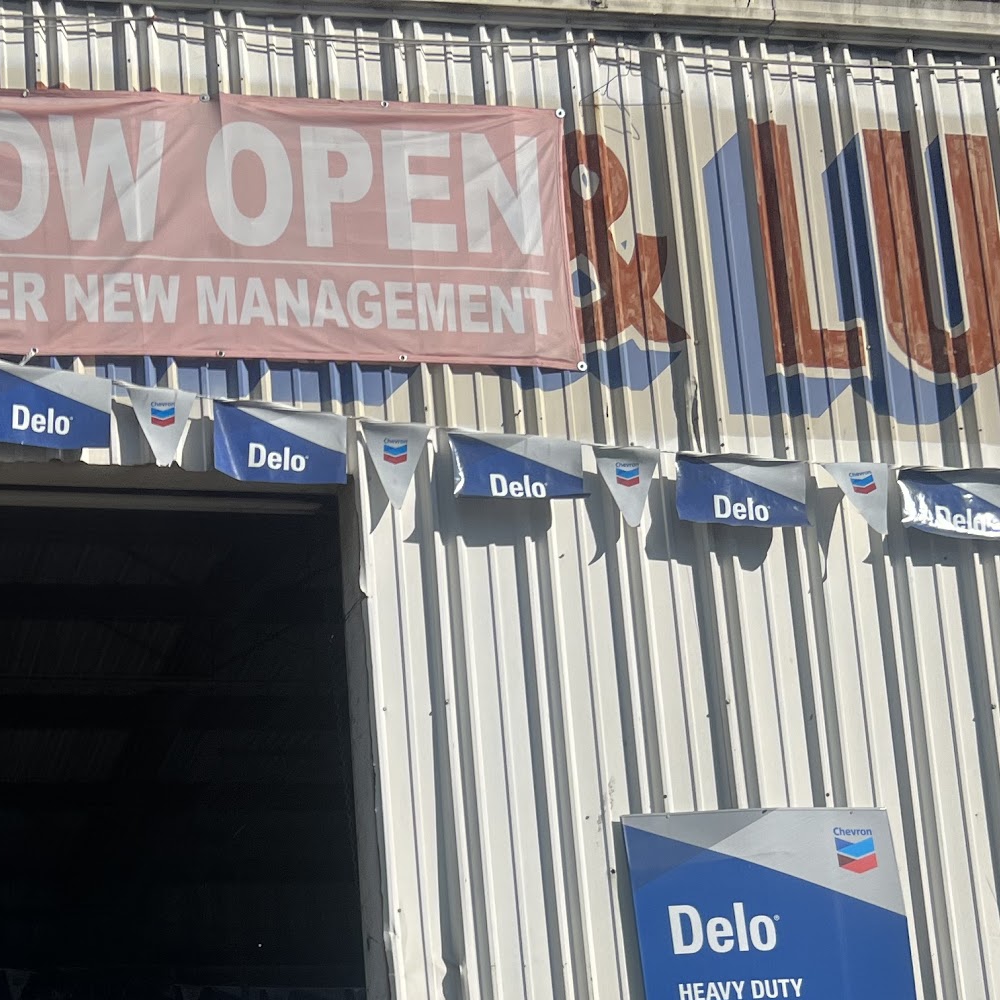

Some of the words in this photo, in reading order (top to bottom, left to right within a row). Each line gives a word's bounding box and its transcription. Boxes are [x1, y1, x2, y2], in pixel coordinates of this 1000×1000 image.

[204, 120, 546, 257] OPEN
[64, 272, 179, 325] NEW
[198, 275, 554, 337] MANAGEMENT
[11, 403, 70, 436] Delo
[247, 442, 306, 473] Delo
[489, 473, 547, 498] Delo
[713, 494, 770, 522] Delo
[832, 826, 873, 837] Chevron
[750, 978, 803, 999] DUTY
